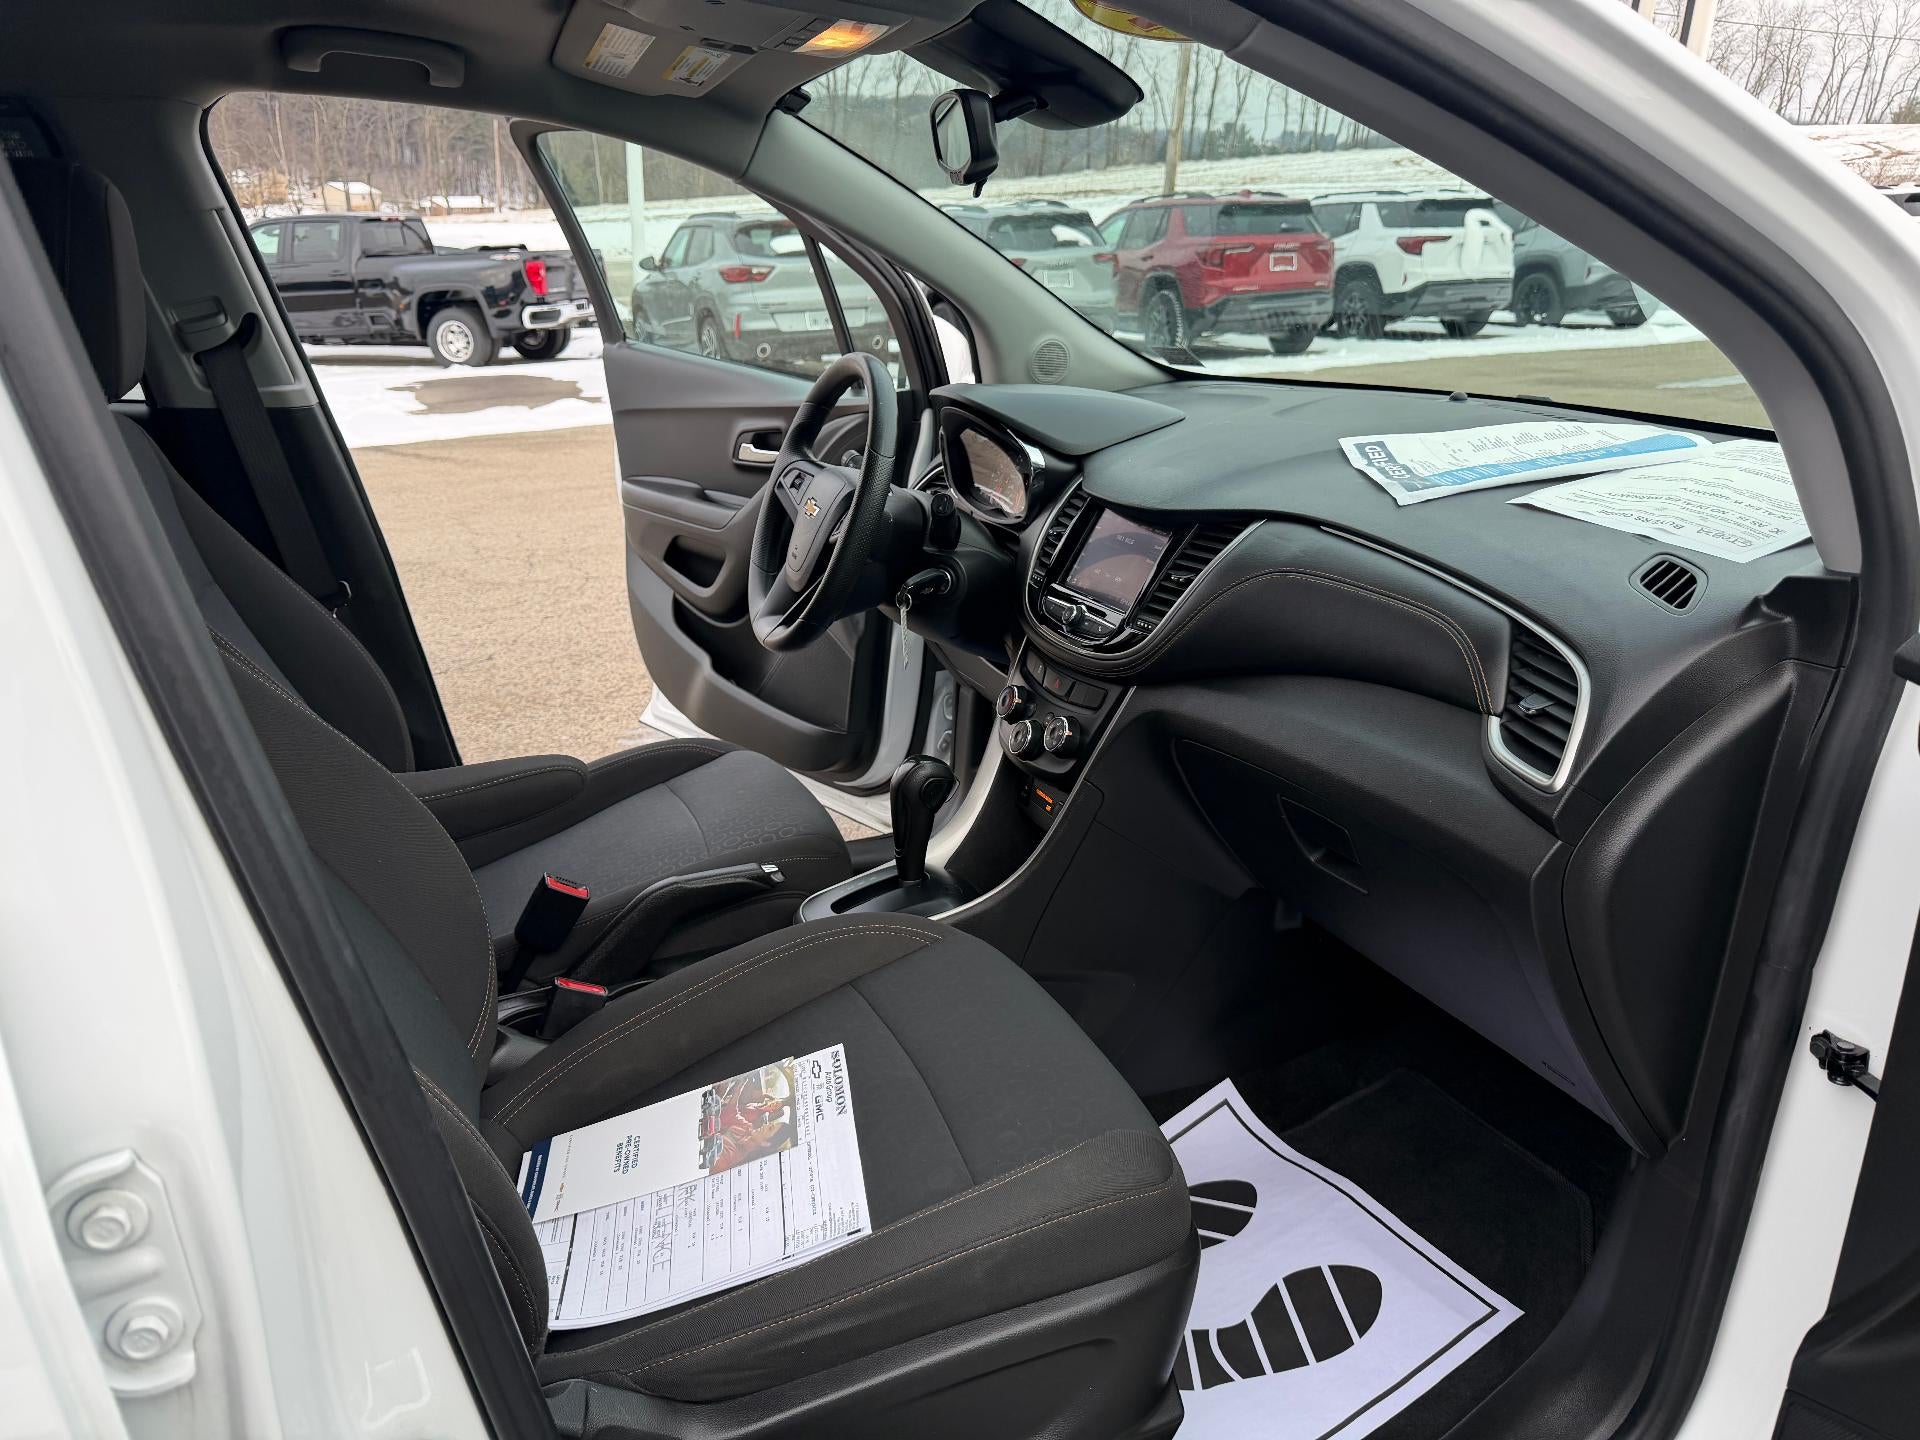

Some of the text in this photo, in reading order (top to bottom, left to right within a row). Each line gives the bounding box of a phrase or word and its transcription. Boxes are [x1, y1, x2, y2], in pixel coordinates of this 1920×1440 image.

[1364, 445, 1411, 479] CERFIED
[825, 1085, 833, 1103] Group
[831, 1050, 847, 1117] SOLOMON
[814, 1095, 824, 1123] GMC
[613, 1142, 624, 1173] BENEFITS
[621, 1134, 633, 1175] PRE-OWNED
[630, 1135, 641, 1169] CERTIFIED
